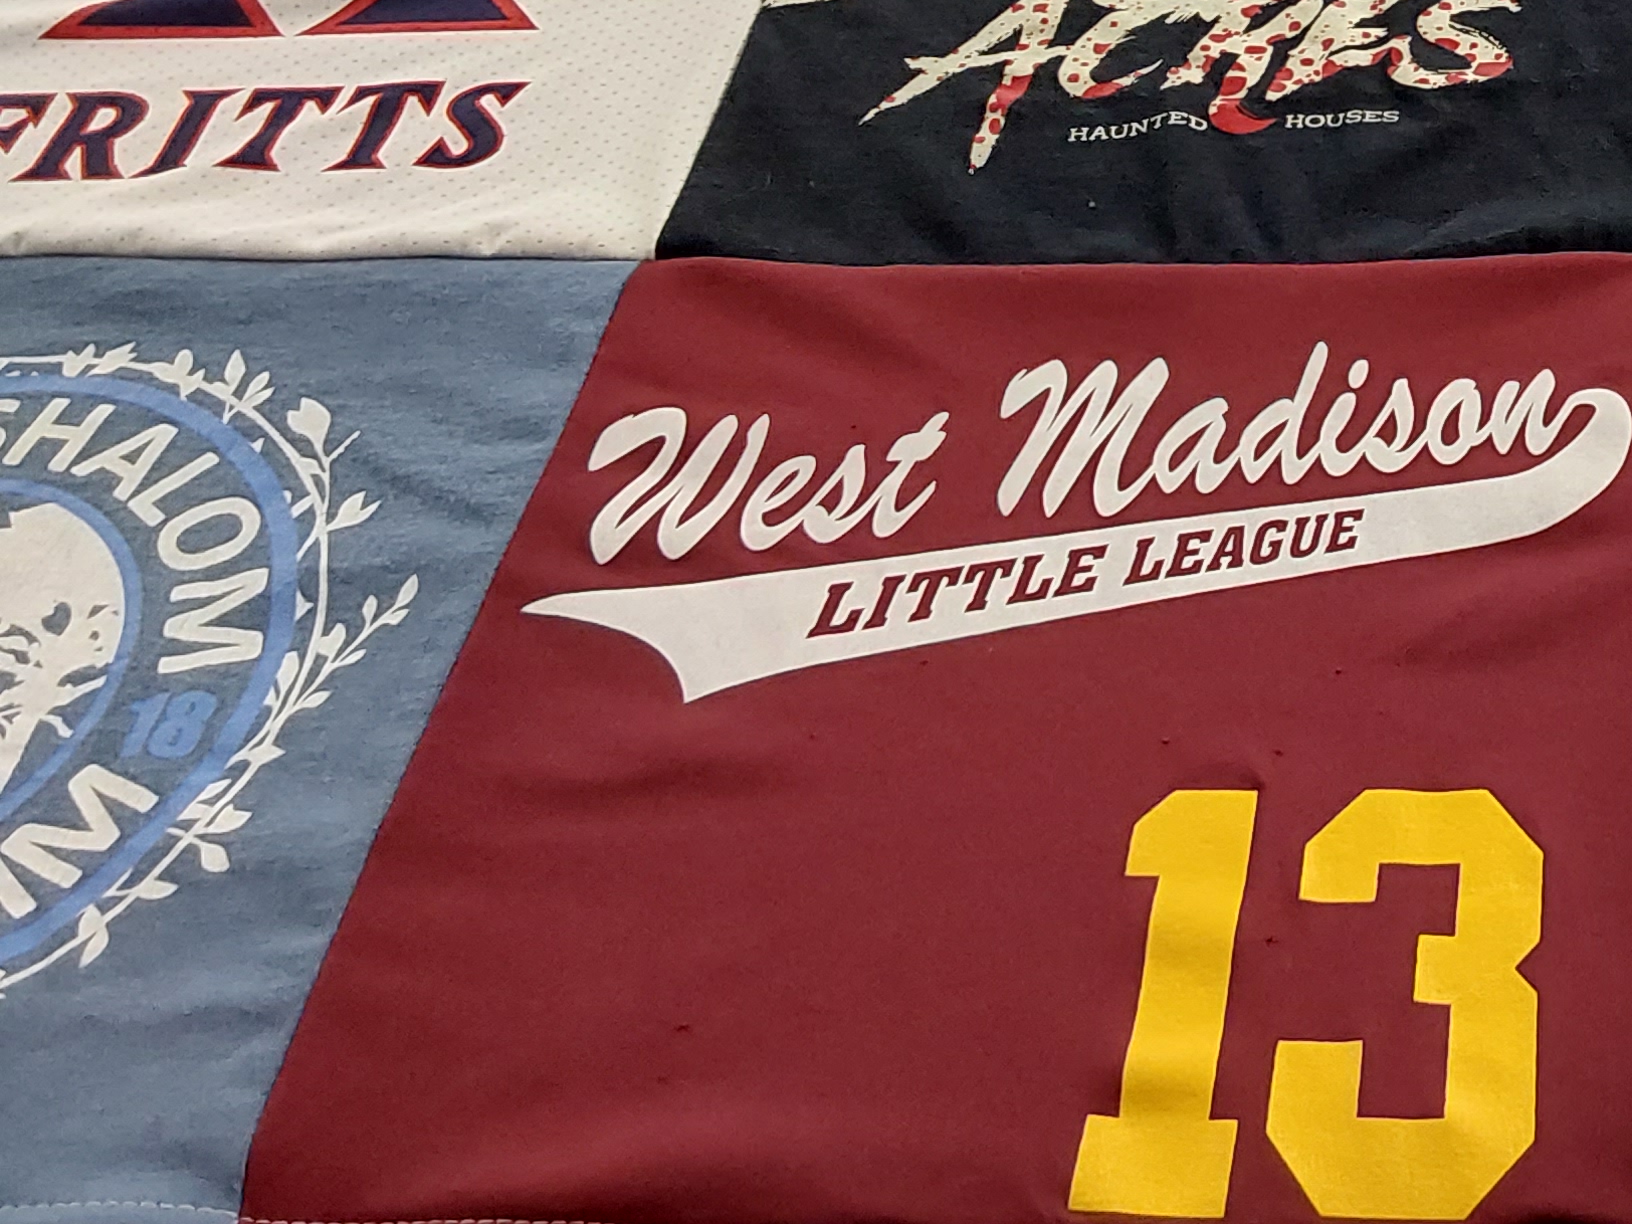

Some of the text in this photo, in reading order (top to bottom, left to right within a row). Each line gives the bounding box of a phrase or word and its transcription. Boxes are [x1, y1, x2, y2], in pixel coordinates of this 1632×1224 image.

[0, 80, 533, 182] FRITTS
[1067, 110, 1400, 144] HAUNTED HOUSES
[585, 341, 1566, 565] West Madison
[806, 508, 1366, 639] LITTLE LEAGUE
[119, 689, 217, 760] 18
[1067, 787, 1545, 1219] 13
